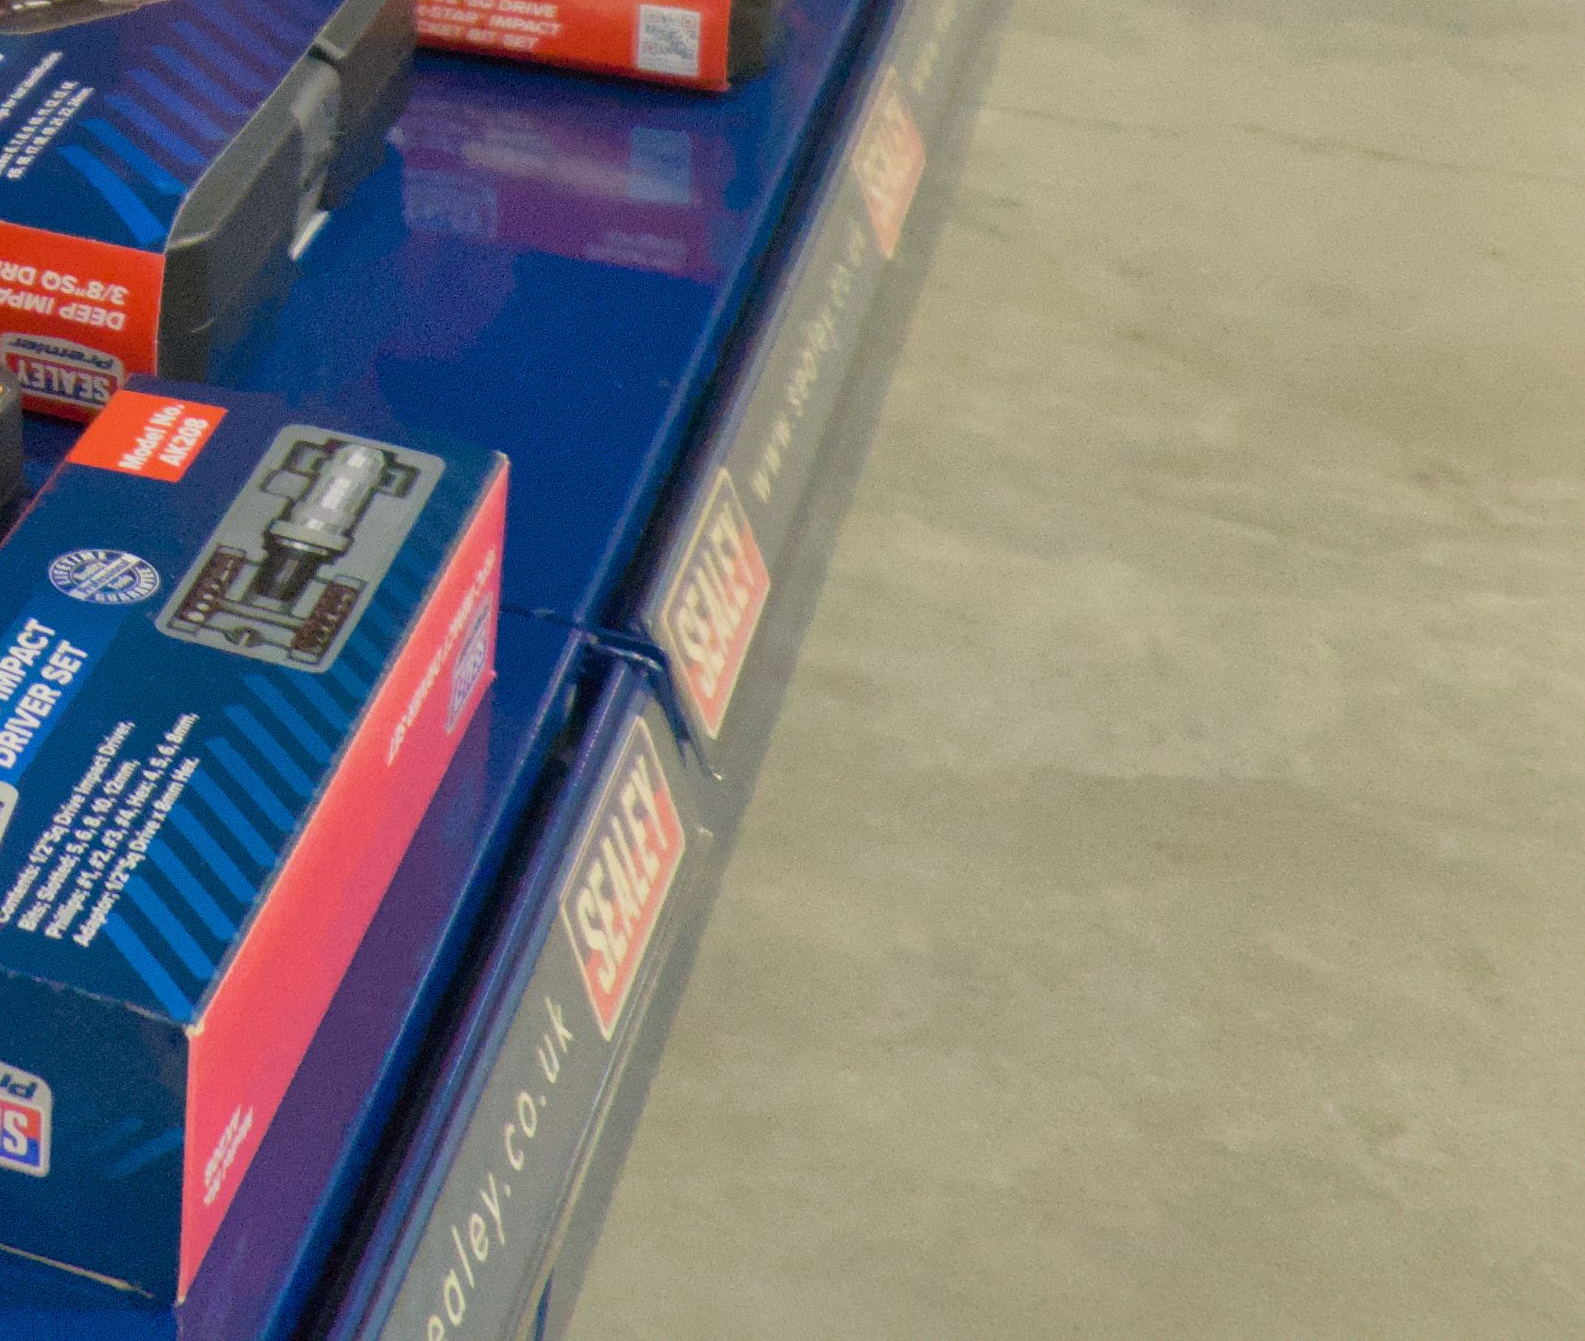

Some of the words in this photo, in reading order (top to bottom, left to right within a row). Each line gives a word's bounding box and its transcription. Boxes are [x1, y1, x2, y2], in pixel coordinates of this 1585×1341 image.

[57, 297, 126, 331] DEEP
[117, 426, 163, 471] Model
[154, 404, 185, 433] No.
[159, 418, 209, 468] AK208
[676, 507, 756, 701] SEALEY
[41, 641, 89, 685] SET
[576, 752, 668, 998] SEALEY
